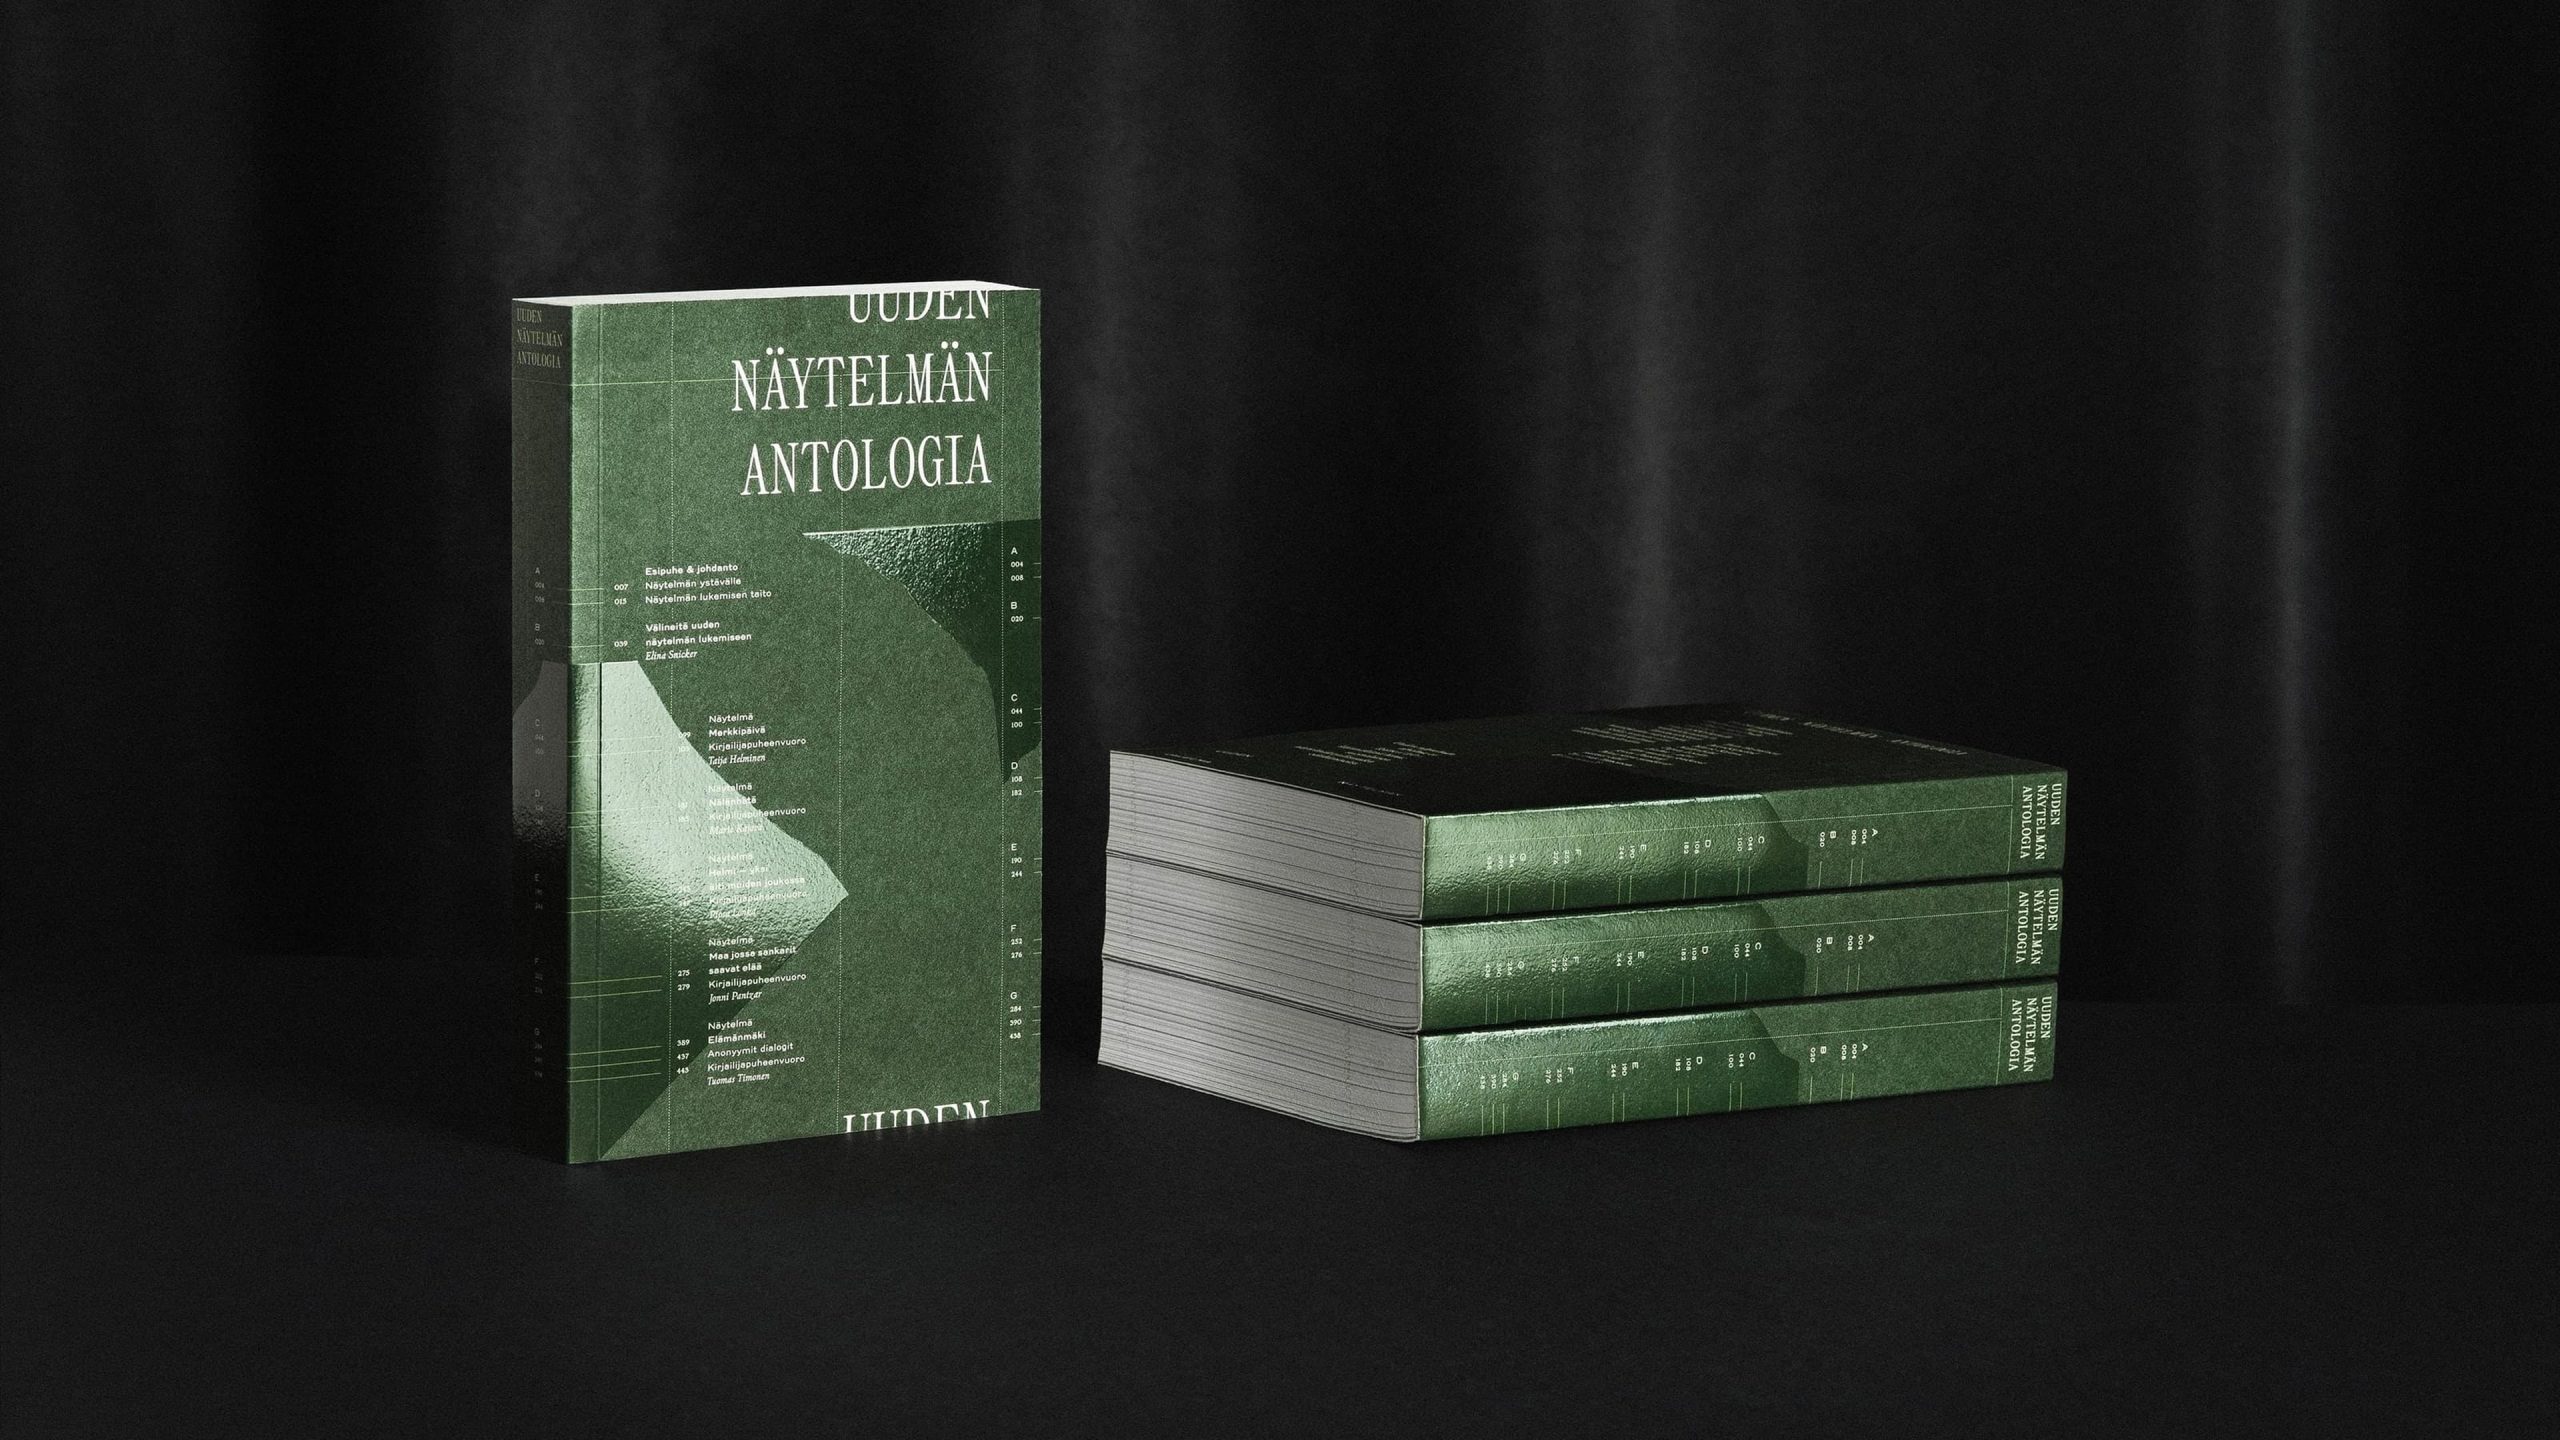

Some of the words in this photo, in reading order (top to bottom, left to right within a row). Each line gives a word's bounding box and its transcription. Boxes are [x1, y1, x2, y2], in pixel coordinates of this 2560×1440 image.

[517, 351, 561, 369] ANTOLOGIA
[731, 341, 993, 412] NÄYTELMÄN
[740, 434, 992, 496] ANTOLOGIA
[1010, 547, 1018, 555] A
[645, 566, 683, 577] Esipuhe
[697, 564, 738, 575] johdanto
[645, 580, 696, 591] Näytelmän
[699, 578, 741, 589] ystävälle
[645, 595, 696, 606] Näytelmän
[700, 591, 747, 601] lukemisen
[750, 590, 772, 599] taito
[645, 622, 688, 632] Välineitä
[692, 621, 720, 630] uuden
[645, 637, 695, 648] näytelmän
[699, 633, 752, 643] lukemiseen
[645, 651, 666, 661] Elina
[668, 650, 698, 660] Snicker
[1011, 693, 1018, 702] C
[708, 713, 754, 724] Näytelmä
[708, 726, 766, 738] Merkkipäivä
[708, 738, 806, 751] Kirjailijapuheenvuoro
[708, 756, 727, 768] Taija
[730, 754, 766, 764] Helminen
[1011, 762, 1018, 770] D
[2050, 783, 2062, 826] UUDEN
[2020, 786, 2033, 859] ANTOLOGIA
[2035, 784, 2048, 860] NÄYTELMÄN
[1872, 828, 1878, 837] A
[1758, 836, 1765, 844] C
[1011, 843, 1017, 851] E
[2048, 888, 2059, 931] UUDEN
[1011, 924, 1017, 932] F
[2016, 891, 2029, 964] ANTOLOGIA
[2031, 890, 2044, 965] NÄYTELMÄN
[708, 936, 754, 947] Näytelmä
[1826, 936, 1833, 945] B
[1868, 934, 1875, 942] A
[1701, 946, 1709, 954] D
[1755, 942, 1762, 950] C
[709, 952, 729, 961] Maa
[731, 950, 755, 961] jossa
[758, 946, 797, 956] sankarit
[708, 966, 740, 975] saavat
[742, 962, 762, 972] elää
[708, 973, 806, 989] Kirjailijapuheenvuoro
[708, 993, 729, 1005] Jonni
[1010, 992, 1018, 1000] G
[2041, 996, 2052, 1039] UUDEN
[708, 1019, 753, 1030] Näytelmä
[708, 1031, 766, 1044] Elämänmäki
[2008, 999, 2022, 1072] ANTOLOGIA
[2024, 998, 2037, 1073] NÄYTELMÄN
[708, 1046, 757, 1058] Anonyymit
[760, 1042, 793, 1053] dialogit
[1820, 1046, 1827, 1054] B
[1862, 1043, 1868, 1051] A
[1696, 1056, 1703, 1064] D
[1749, 1052, 1756, 1060] C
[708, 1056, 805, 1072] Kirjailijapuheenvuoro
[1632, 1061, 1639, 1069] E
[707, 1076, 735, 1086] Tuomas
[738, 1073, 770, 1082] Timonen
